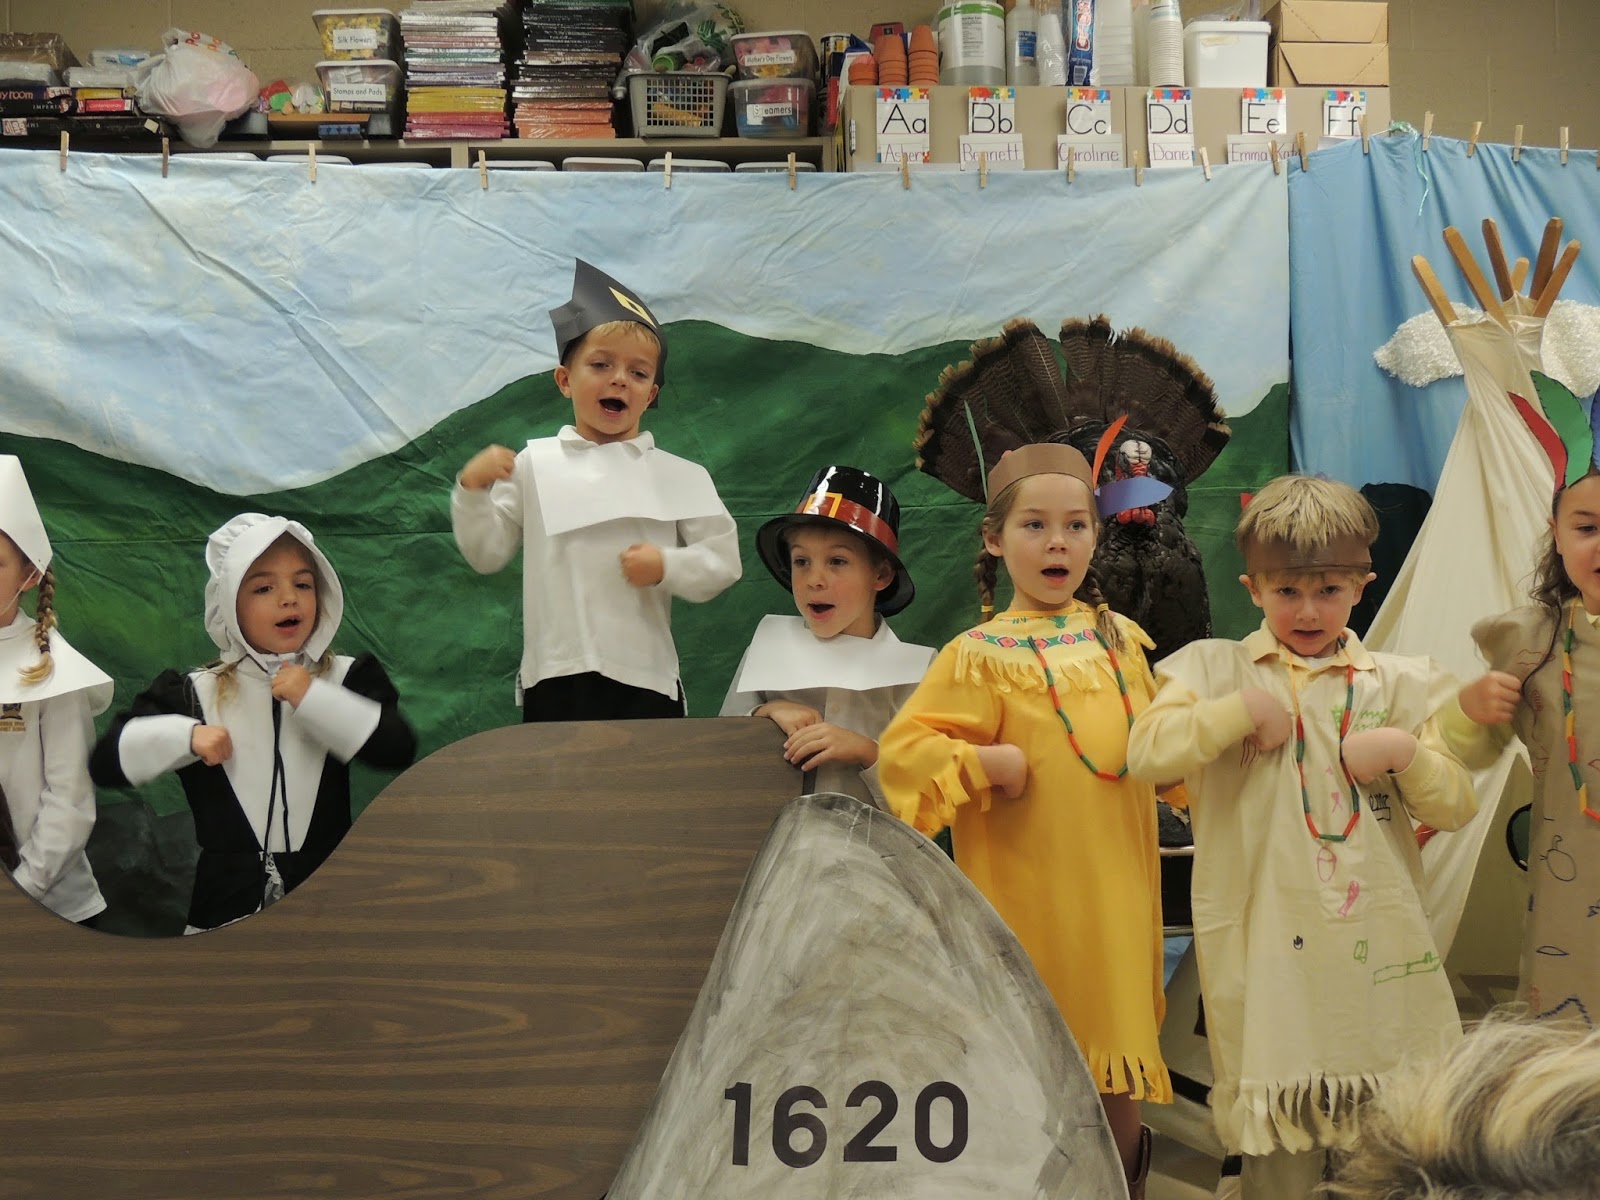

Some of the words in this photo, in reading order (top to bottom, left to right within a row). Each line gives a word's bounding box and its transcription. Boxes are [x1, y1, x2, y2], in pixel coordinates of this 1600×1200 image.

[334, 88, 354, 96] Stamps
[754, 106, 791, 115] Sreamers
[882, 103, 927, 134] Aa
[971, 102, 1013, 134] Bb
[1067, 104, 1107, 135] Cc
[1149, 104, 1188, 134] Dd
[1247, 103, 1281, 134] Ee
[1328, 105, 1363, 136] Ff
[884, 143, 922, 162] Asher
[1153, 143, 1189, 161] Dane
[1231, 142, 1268, 162] Emma
[724, 1080, 969, 1169] 1620
